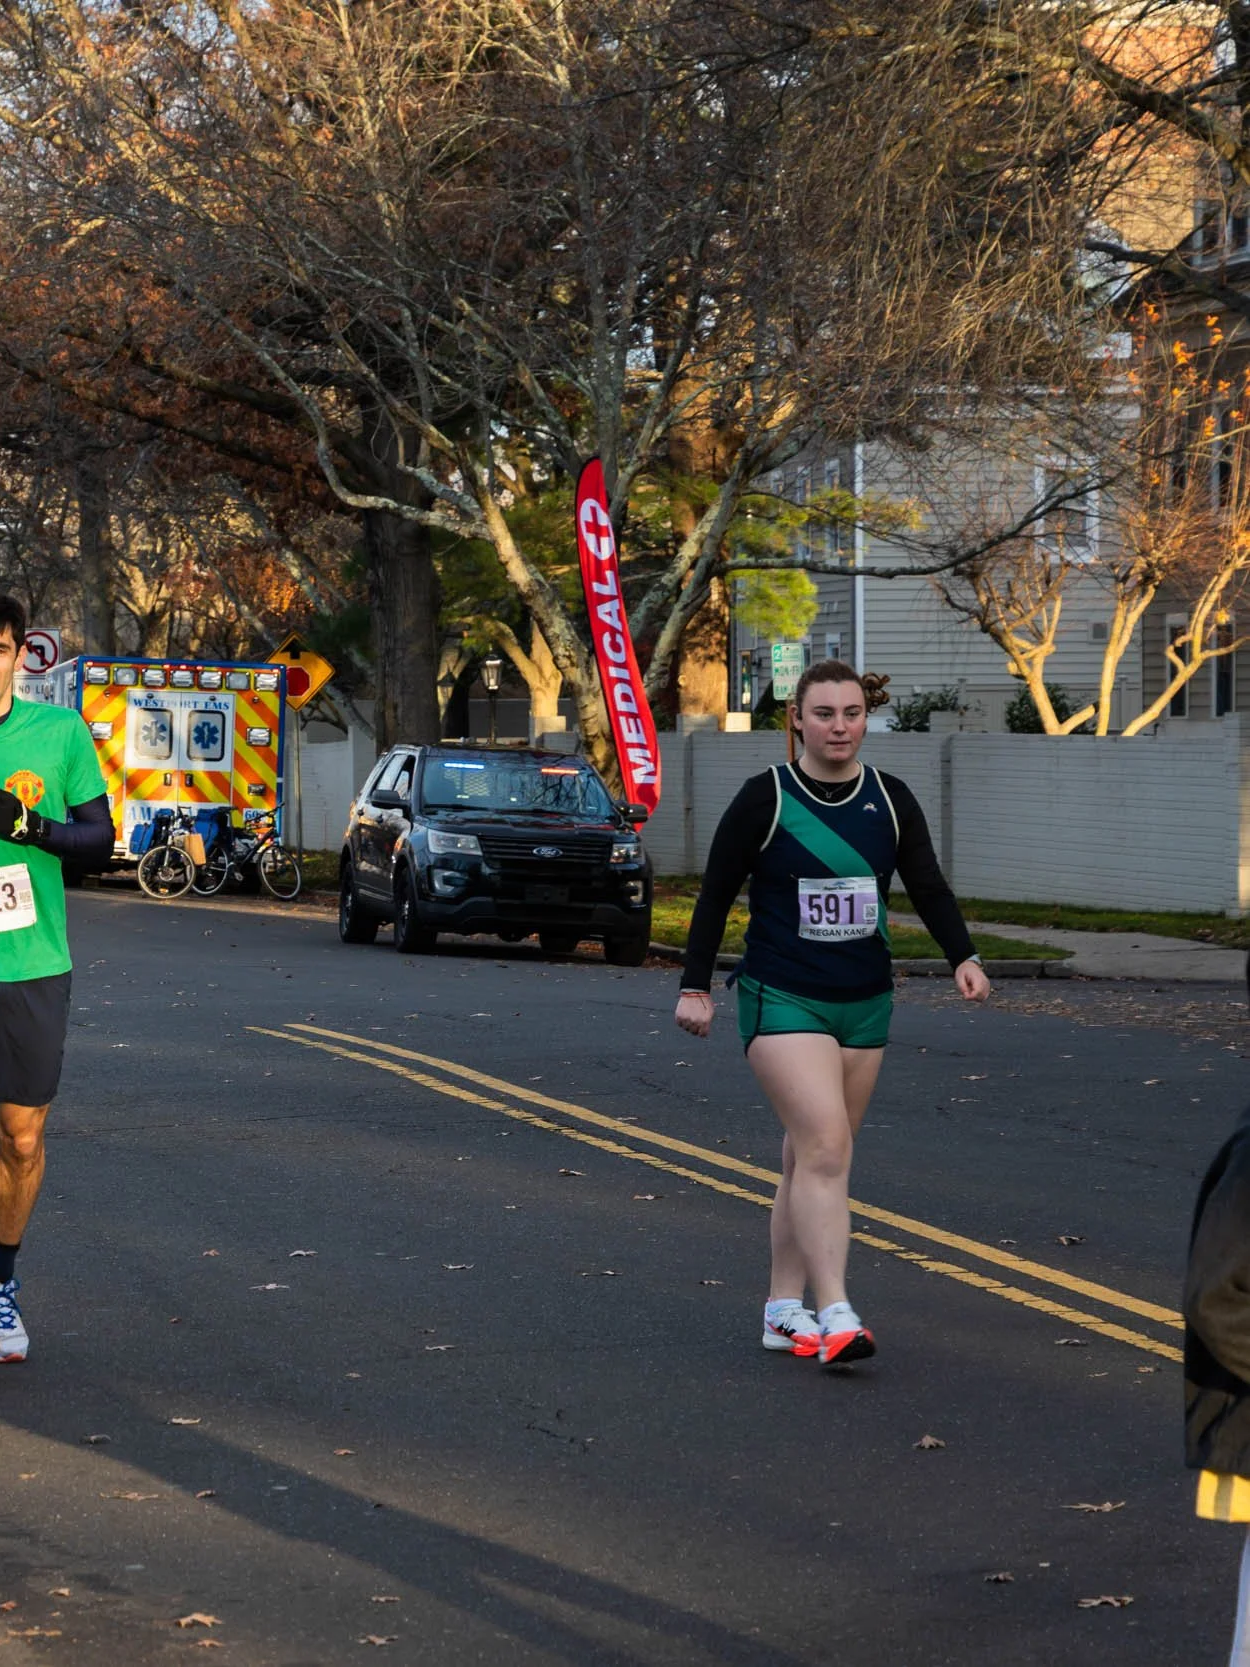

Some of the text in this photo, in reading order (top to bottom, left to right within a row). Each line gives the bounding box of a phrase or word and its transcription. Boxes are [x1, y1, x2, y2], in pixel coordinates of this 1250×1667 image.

[592, 569, 658, 785] MEDICAL
[204, 701, 230, 710] EMS
[808, 893, 854, 925] 591
[809, 927, 868, 937] REGAN KANE
